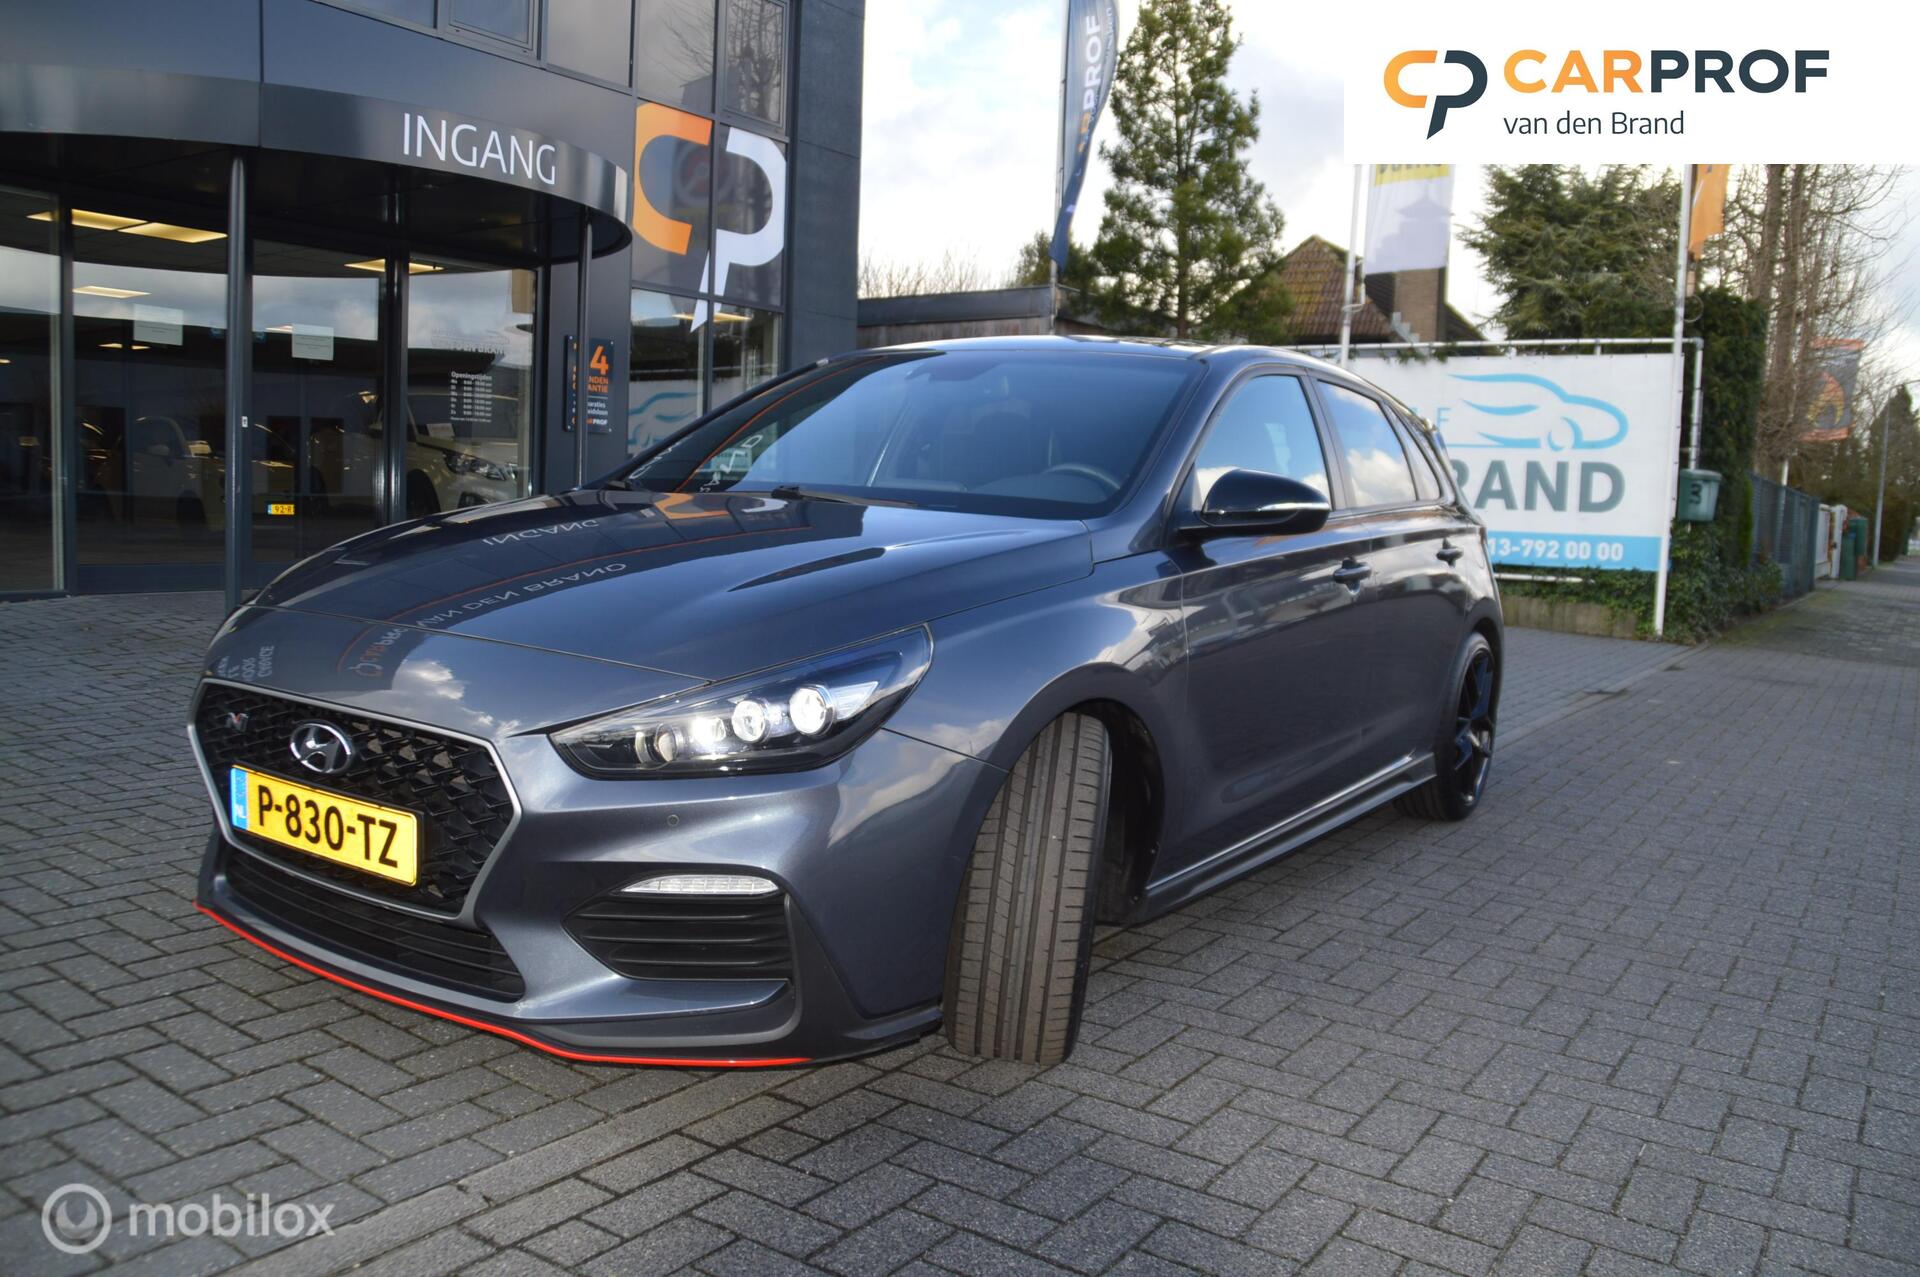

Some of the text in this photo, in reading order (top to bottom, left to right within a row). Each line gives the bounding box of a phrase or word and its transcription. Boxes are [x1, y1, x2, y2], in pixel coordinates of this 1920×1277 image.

[403, 112, 556, 185] INGANG
[1688, 483, 1703, 505] 3
[1565, 541, 1592, 560] 00
[1597, 542, 1624, 561] 00
[258, 784, 398, 869] P-830-TZ
